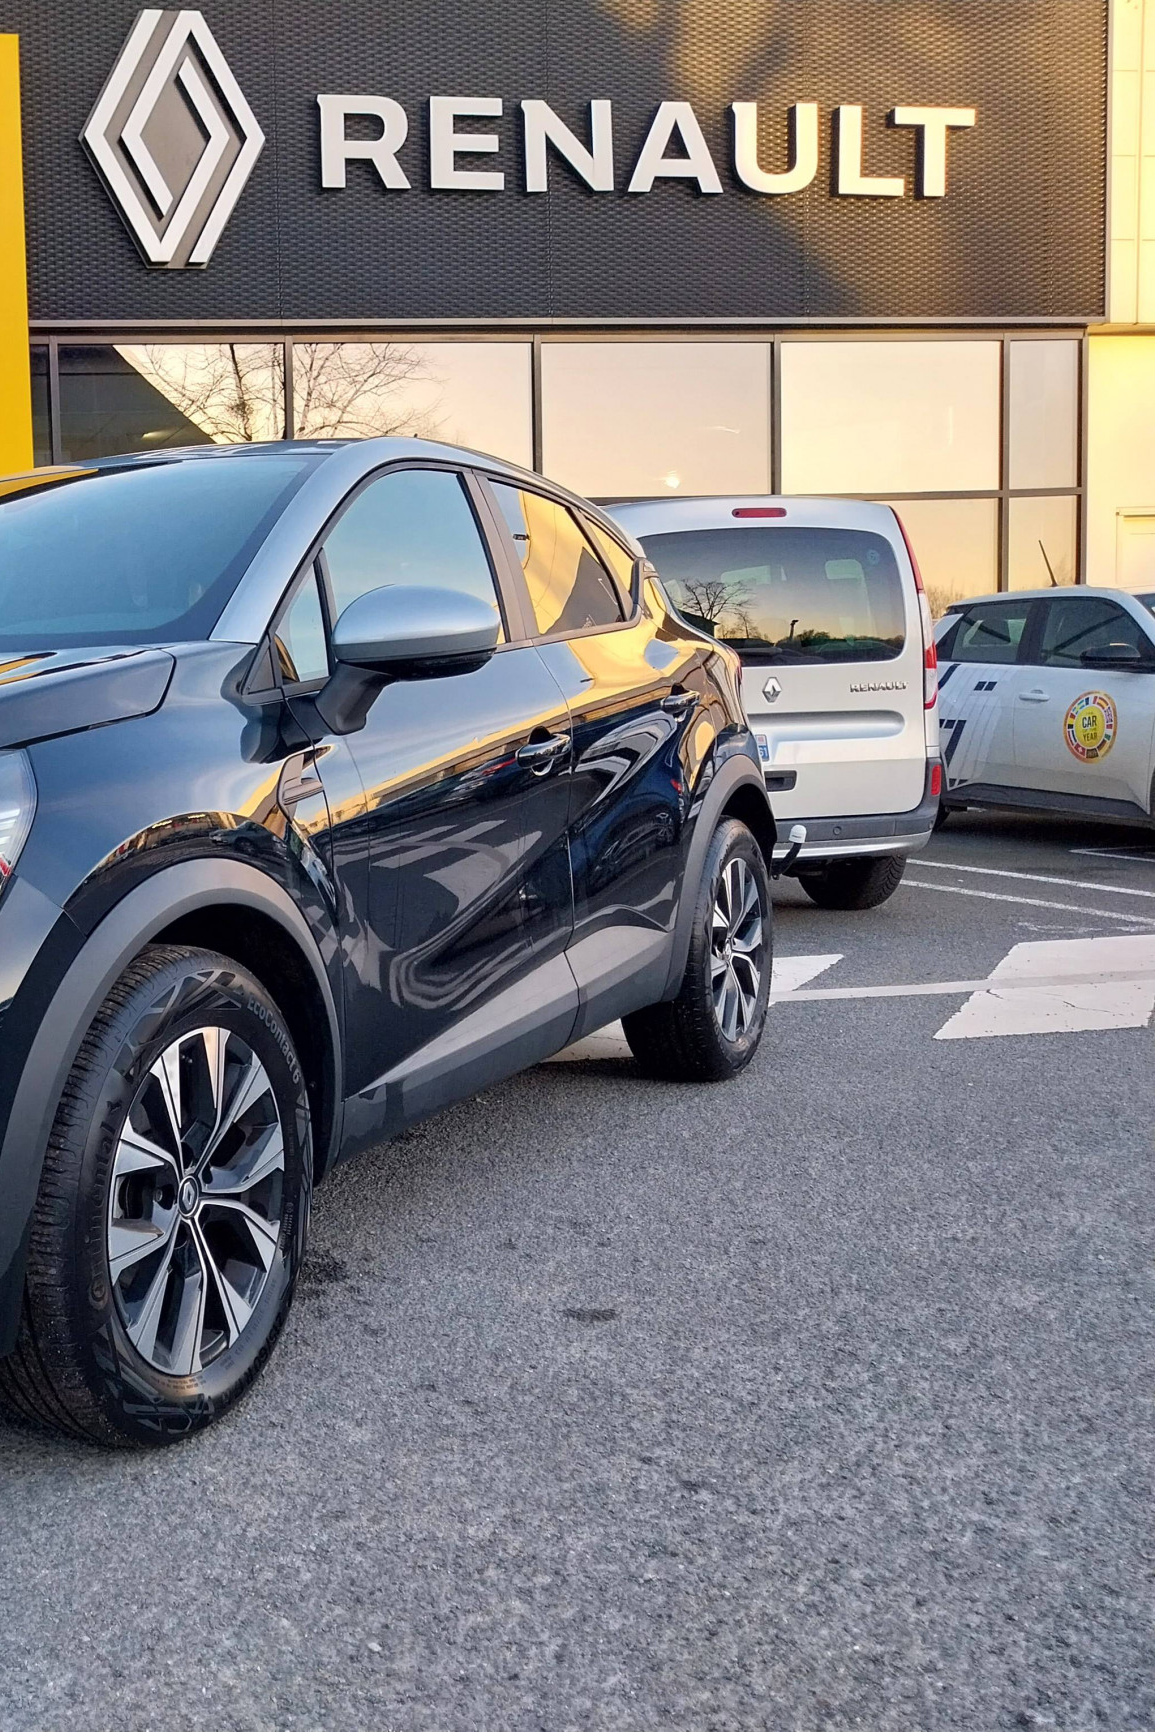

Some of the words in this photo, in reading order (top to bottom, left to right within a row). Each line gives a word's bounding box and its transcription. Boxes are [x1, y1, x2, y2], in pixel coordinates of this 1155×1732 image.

[316, 93, 976, 197] RENAULT
[849, 681, 908, 693] RENAULT
[1081, 715, 1097, 729] CAR
[1082, 732, 1098, 742] YEAR
[247, 994, 297, 1071] EcoContact
[292, 1068, 301, 1084] 6
